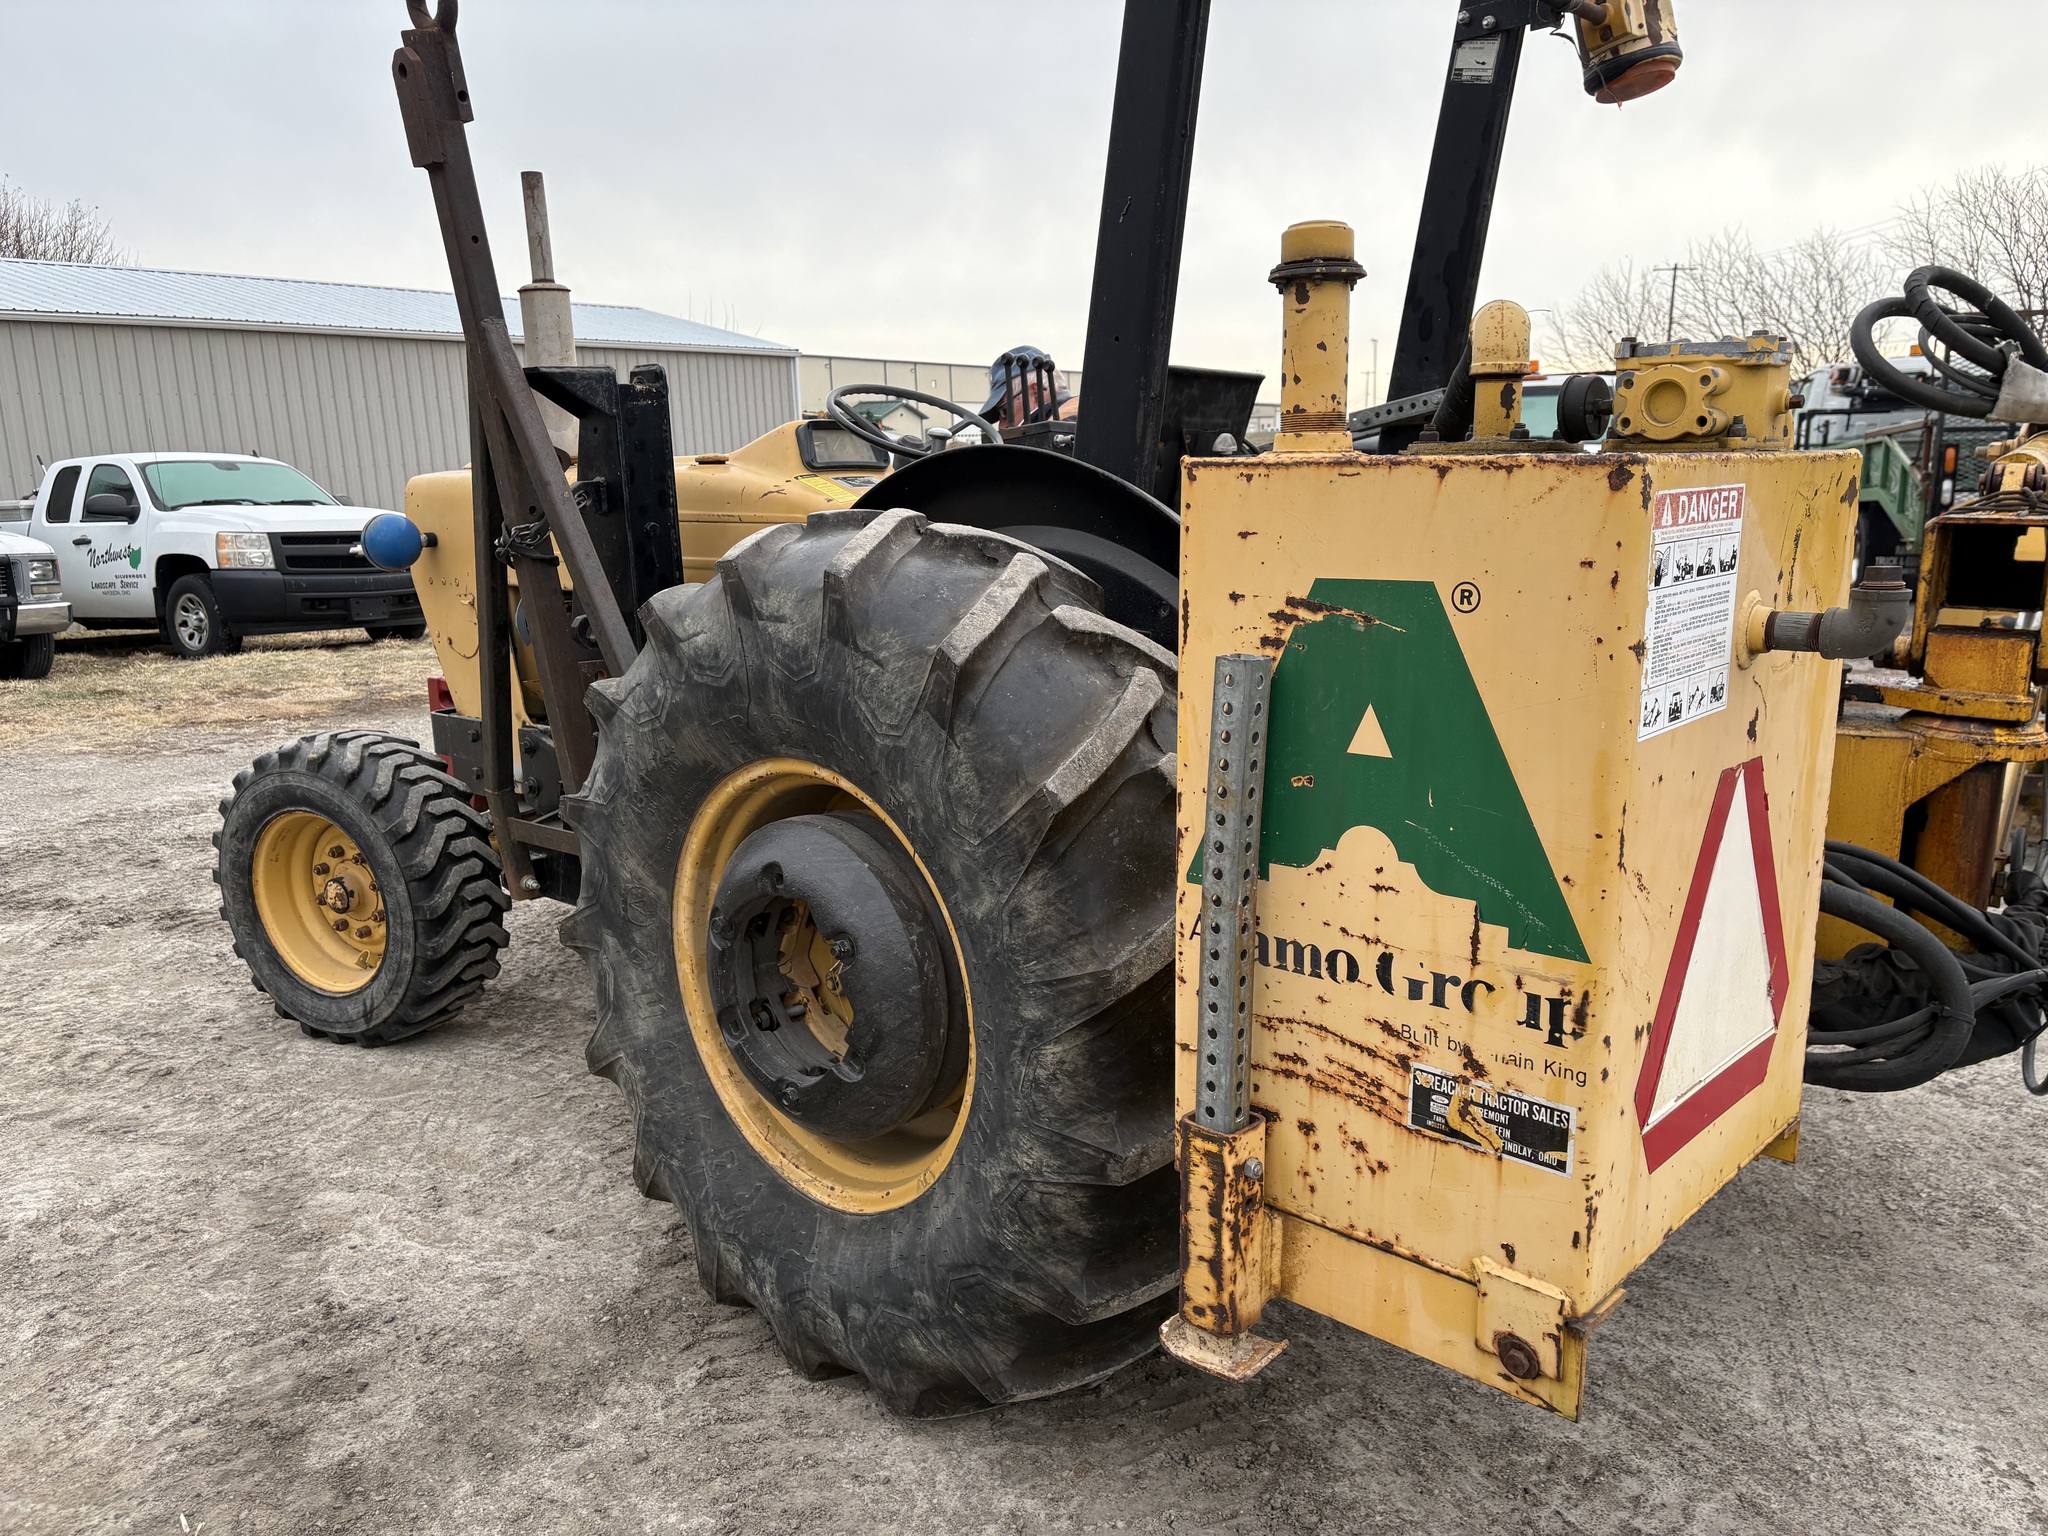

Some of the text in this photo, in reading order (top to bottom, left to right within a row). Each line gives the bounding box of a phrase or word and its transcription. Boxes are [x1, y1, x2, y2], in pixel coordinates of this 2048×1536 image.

[1678, 489, 1738, 525] DANGER
[87, 543, 132, 568] Northwest
[91, 580, 139, 590] LANDSCAPE SERVICE
[1544, 1058, 1587, 1087] King
[1532, 1104, 1569, 1130] SALES
[1501, 1139, 1558, 1166] FINDLAY, OHIO
